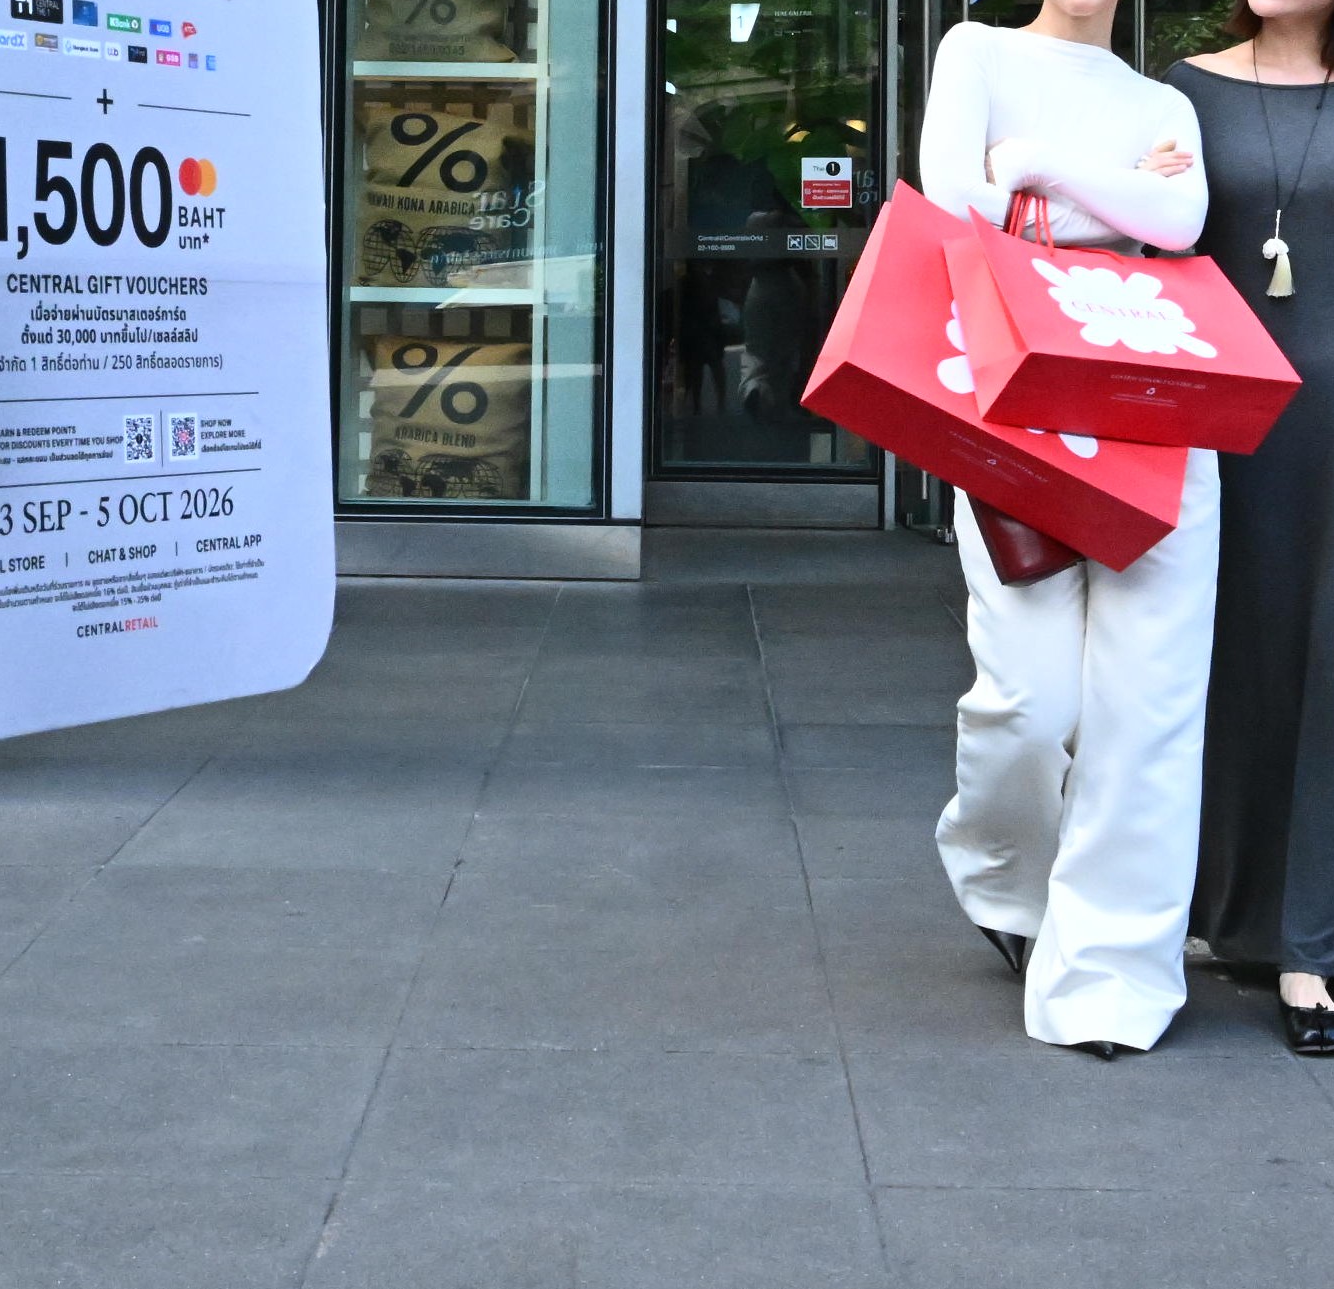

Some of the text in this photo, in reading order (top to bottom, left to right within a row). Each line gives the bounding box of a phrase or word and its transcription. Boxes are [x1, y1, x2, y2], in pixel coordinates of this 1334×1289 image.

[390, 112, 489, 194] %
[178, 205, 226, 229] BAHT
[428, 200, 476, 217] ARABICA
[6, 273, 208, 296] CENTRAL GIFT VOUCHERS
[30, 300, 187, 322] เมื่อจ่ายผ่านบัตรมาสเตอร์การ์ด
[1071, 300, 1175, 321] CENTRAL
[21, 324, 53, 344] ตั้งแต่
[57, 328, 97, 346] 30,000
[31, 356, 38, 371] 1
[41, 352, 100, 371] สิทธิ์ต่อท่าน
[102, 355, 108, 370] /
[111, 354, 133, 370] 250
[391, 342, 489, 425] %
[22, 426, 50, 437] REDEEM
[50, 425, 77, 436] POINTS
[200, 418, 232, 429] SHOP NOW
[201, 429, 246, 440] EXPLORE MORE
[11, 438, 51, 450] DISCOUNTS
[51, 437, 74, 449] EVERY
[74, 436, 90, 447] TIME
[91, 435, 106, 447] YOU
[106, 434, 124, 445] SHOP
[394, 425, 477, 449] ARABICA BLEND
[23, 499, 72, 534] SEP
[96, 495, 110, 528] 5
[118, 491, 173, 525] OCT
[179, 486, 234, 520] 2026
[8, 555, 46, 574] STORE
[87, 548, 118, 564] CHAT
[119, 547, 127, 561] &
[128, 544, 157, 560] SHOP
[195, 536, 241, 554] CENTRAL
[243, 533, 262, 548] APP
[76, 616, 158, 638] CENTRALRETAIL
